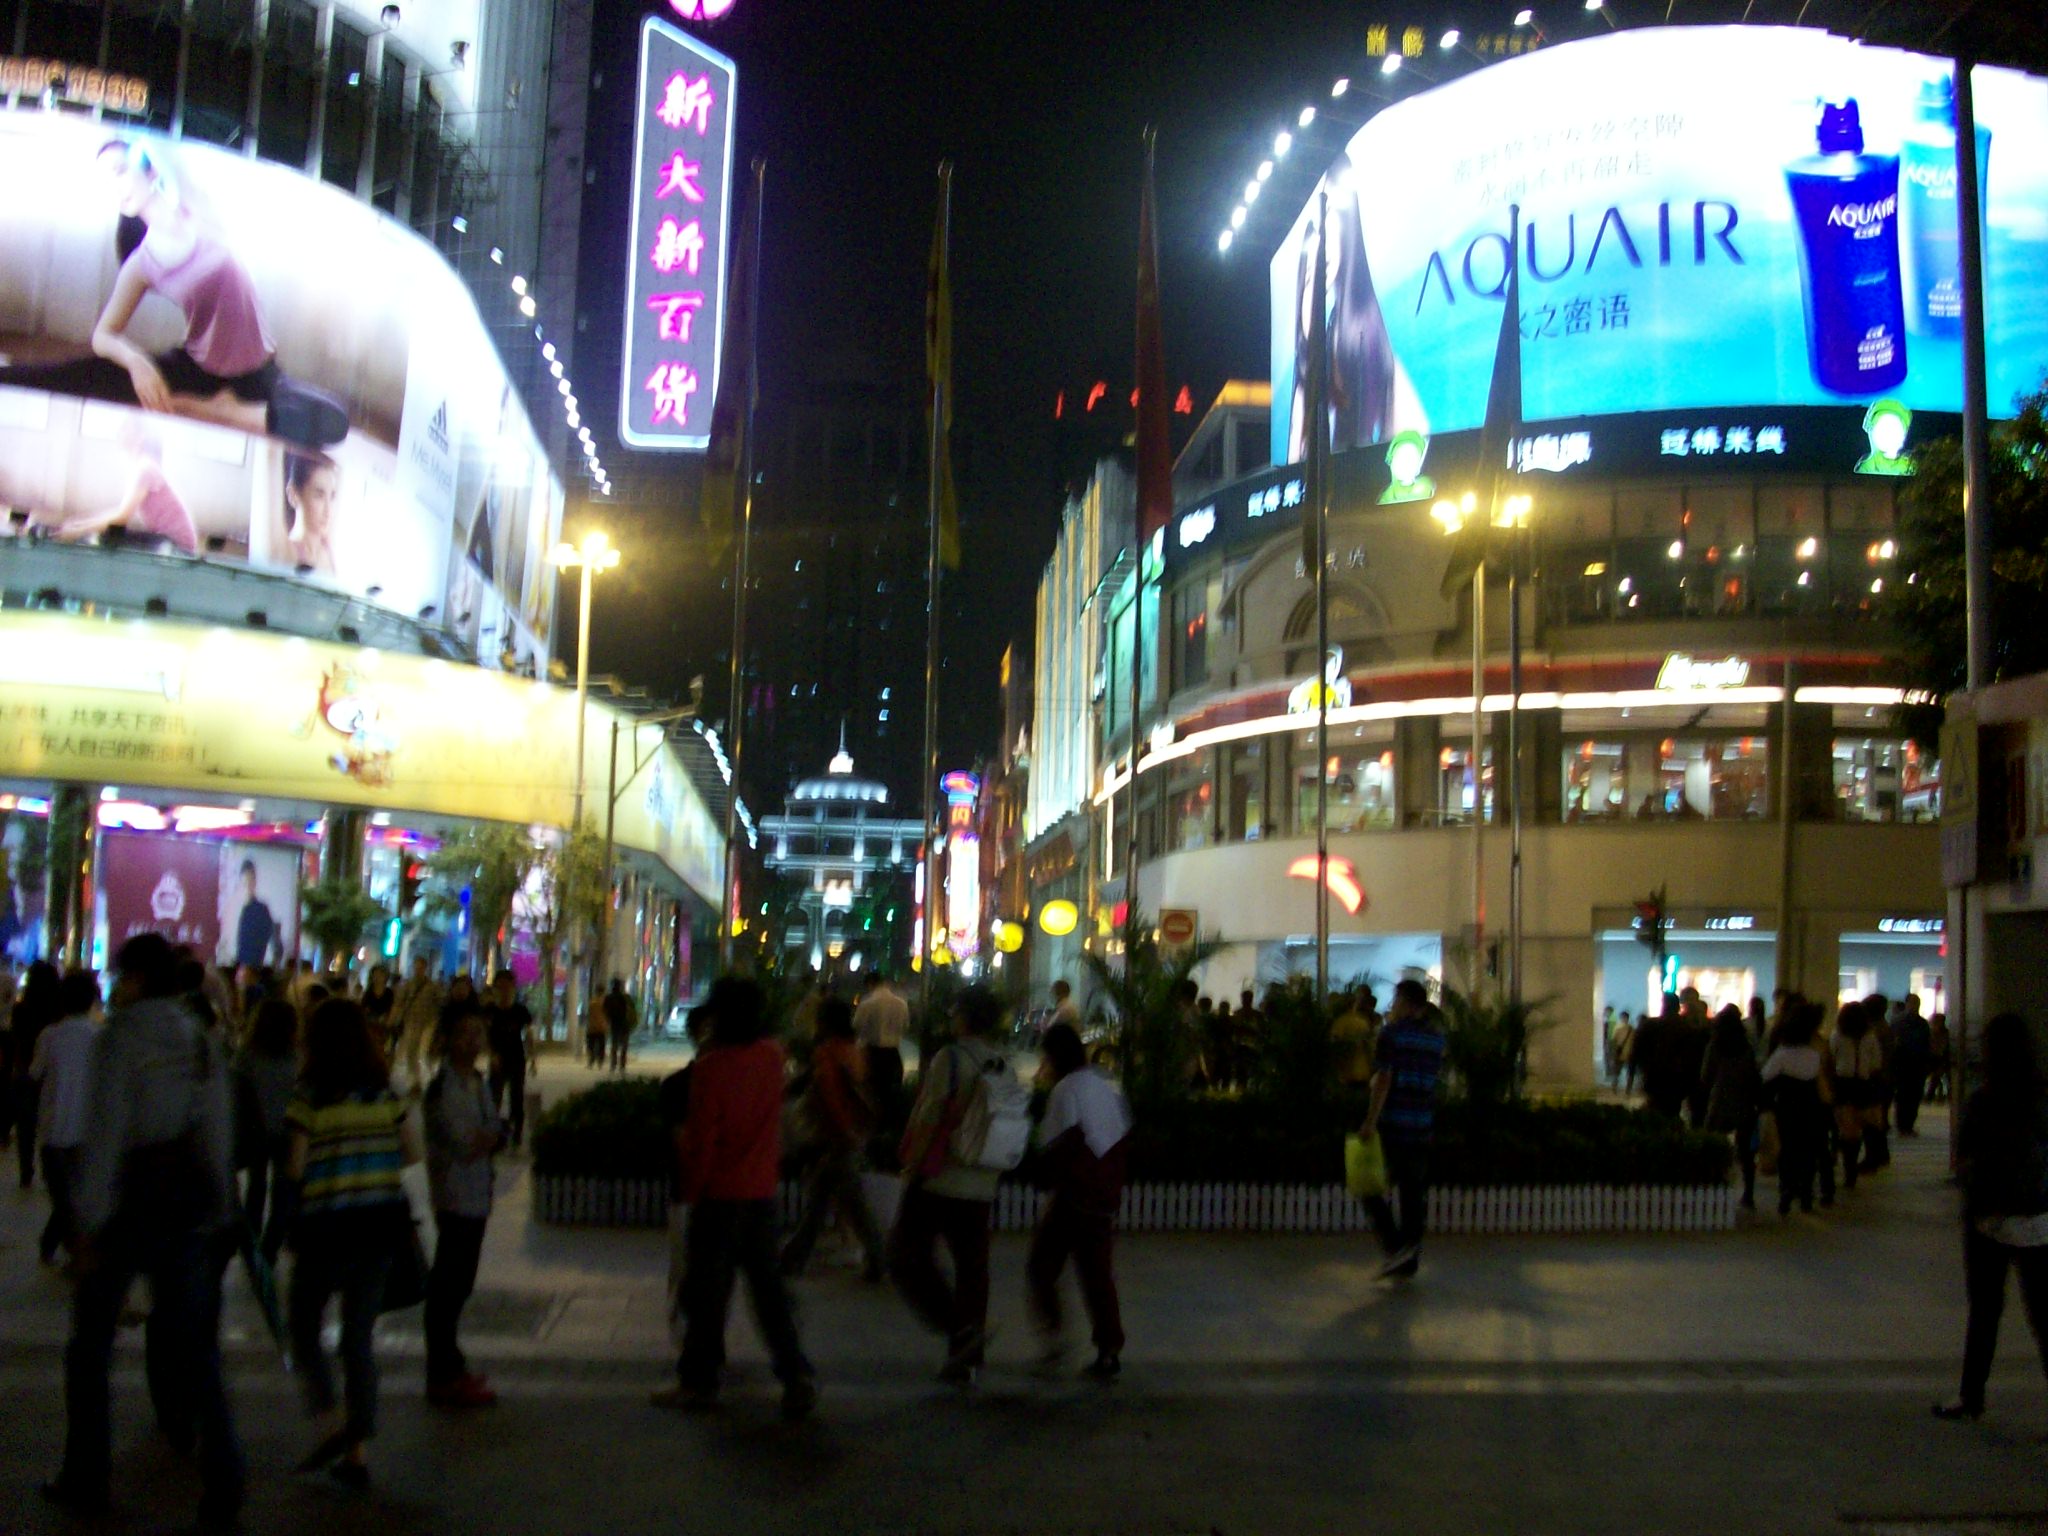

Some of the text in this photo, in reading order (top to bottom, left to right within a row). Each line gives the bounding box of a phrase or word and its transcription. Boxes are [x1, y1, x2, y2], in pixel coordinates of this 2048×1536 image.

[645, 70, 715, 428] 新大新百货
[1415, 200, 1746, 317] AQUAIR
[1827, 193, 1897, 229] AQUAIR
